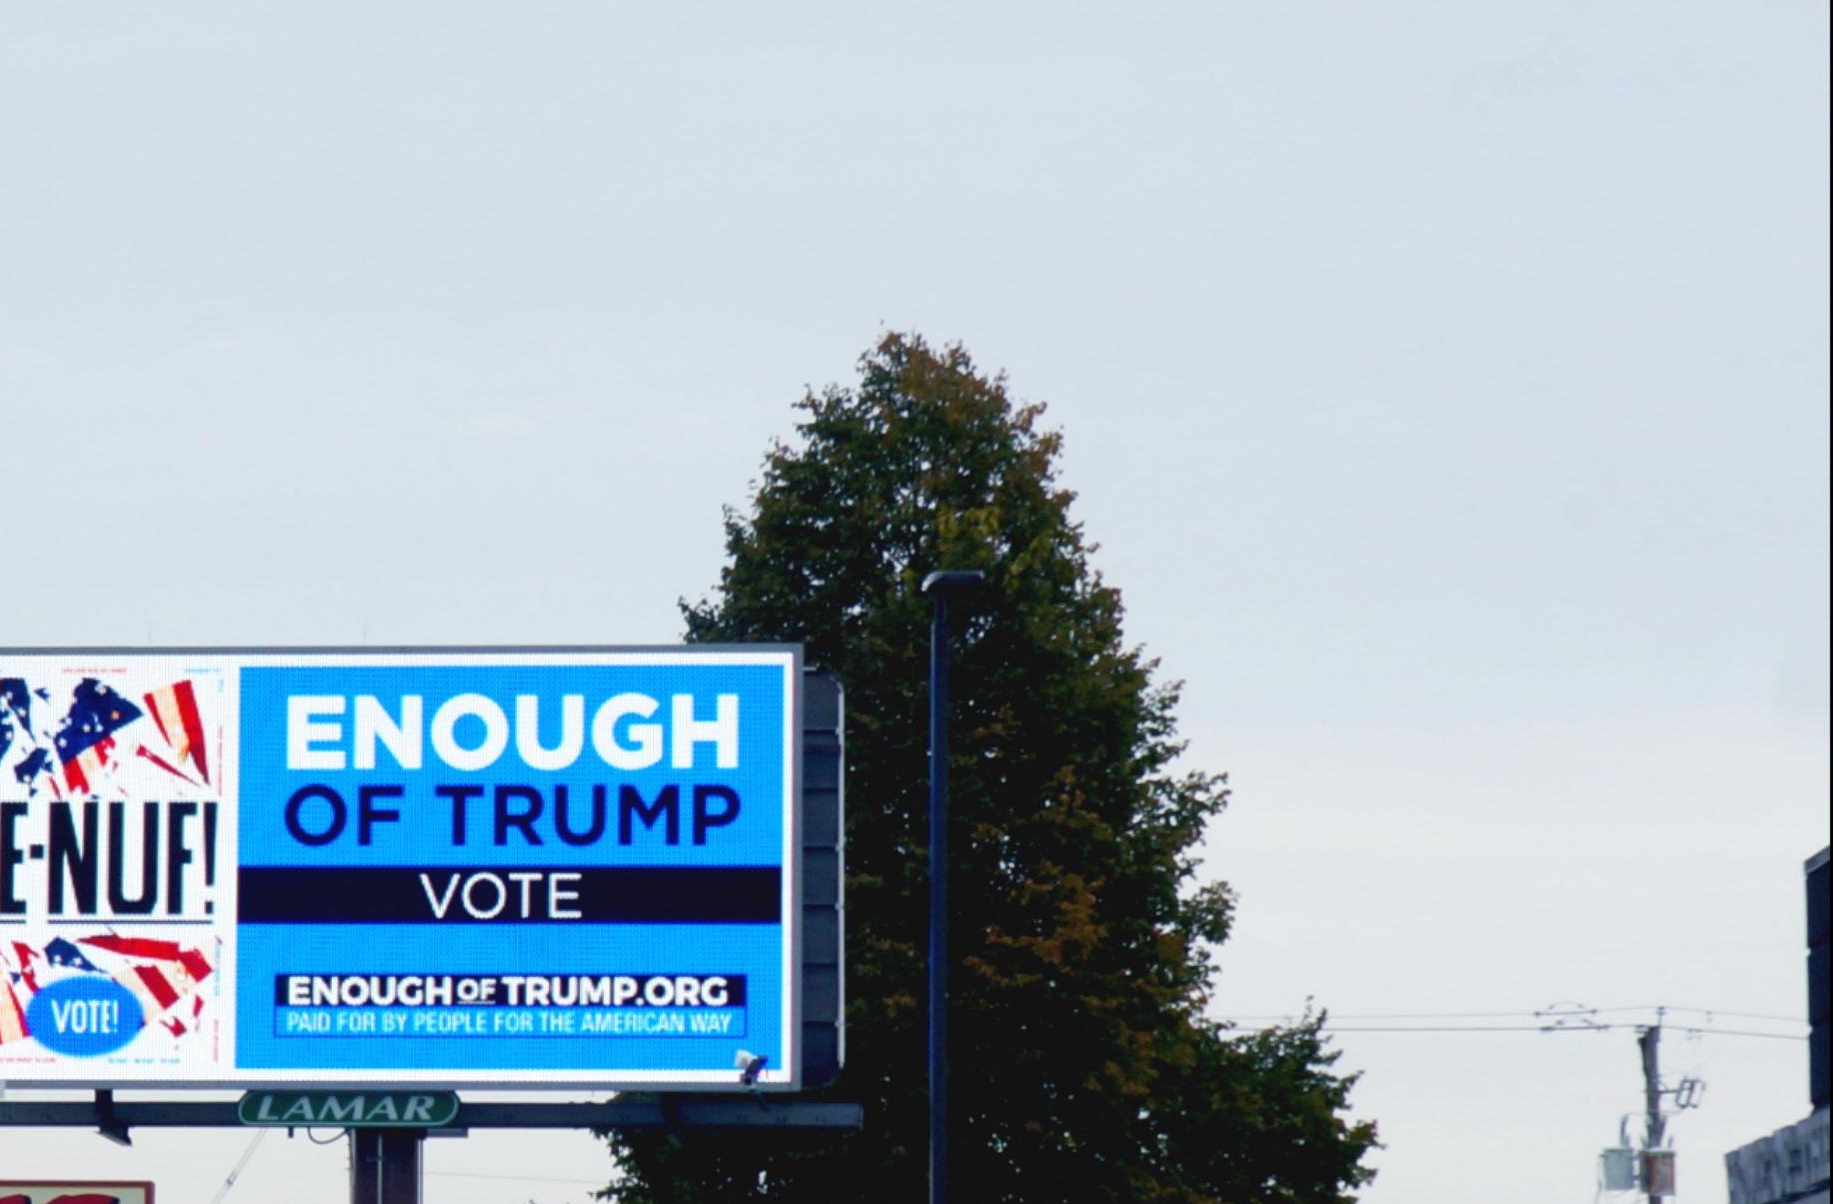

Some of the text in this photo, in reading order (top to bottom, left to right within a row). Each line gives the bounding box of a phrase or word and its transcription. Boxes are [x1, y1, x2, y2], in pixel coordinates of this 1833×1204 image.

[286, 692, 740, 771] ENOUGH
[284, 783, 741, 847] OF TRUMP
[419, 873, 582, 919] VOTE
[288, 976, 729, 1006] ENOUGH OF TRUMP.ORG
[51, 999, 119, 1034] VOTE!
[286, 1011, 733, 1033] PAID FOR BY PEOPLE FOR THE AMERICAN WAY
[256, 1095, 435, 1121] LAMAR
